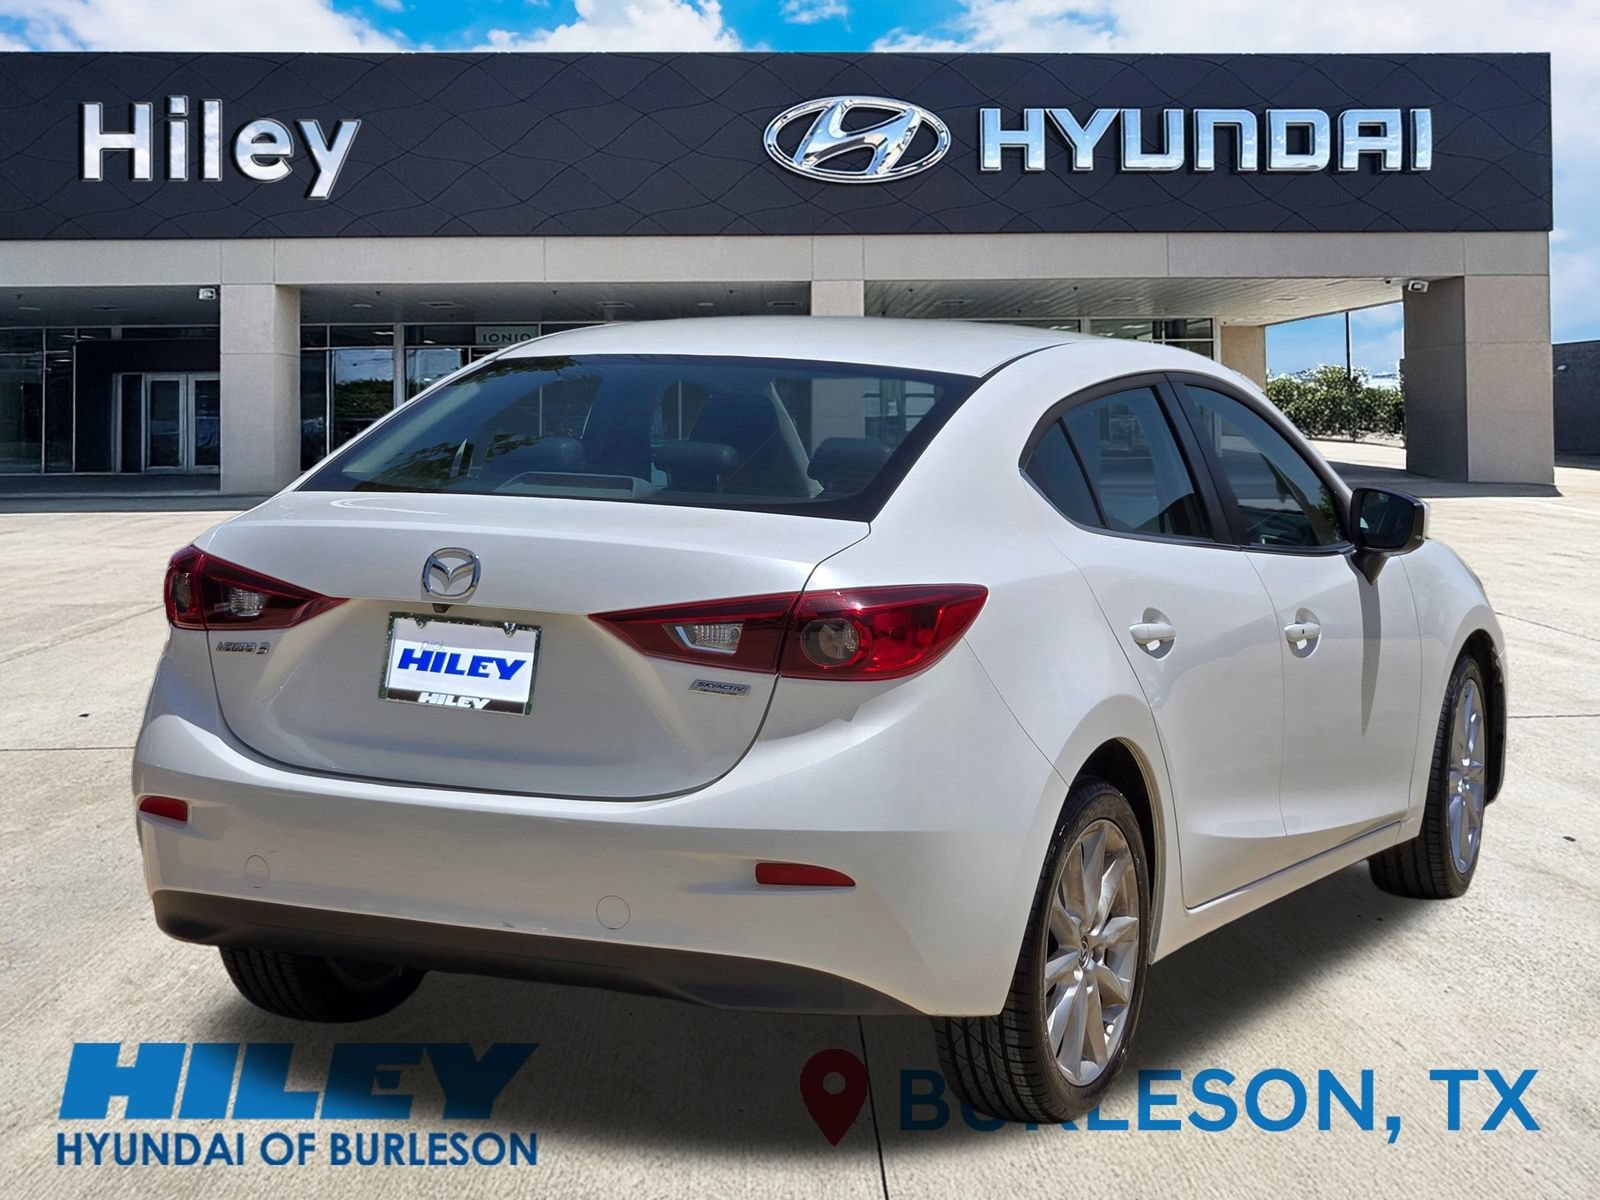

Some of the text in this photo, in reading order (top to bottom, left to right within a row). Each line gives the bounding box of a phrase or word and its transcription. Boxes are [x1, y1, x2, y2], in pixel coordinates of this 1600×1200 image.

[79, 95, 361, 200] Hiley
[978, 107, 1433, 172] HYUNDAI
[398, 648, 526, 680] HILEY
[418, 692, 491, 710] HILEY
